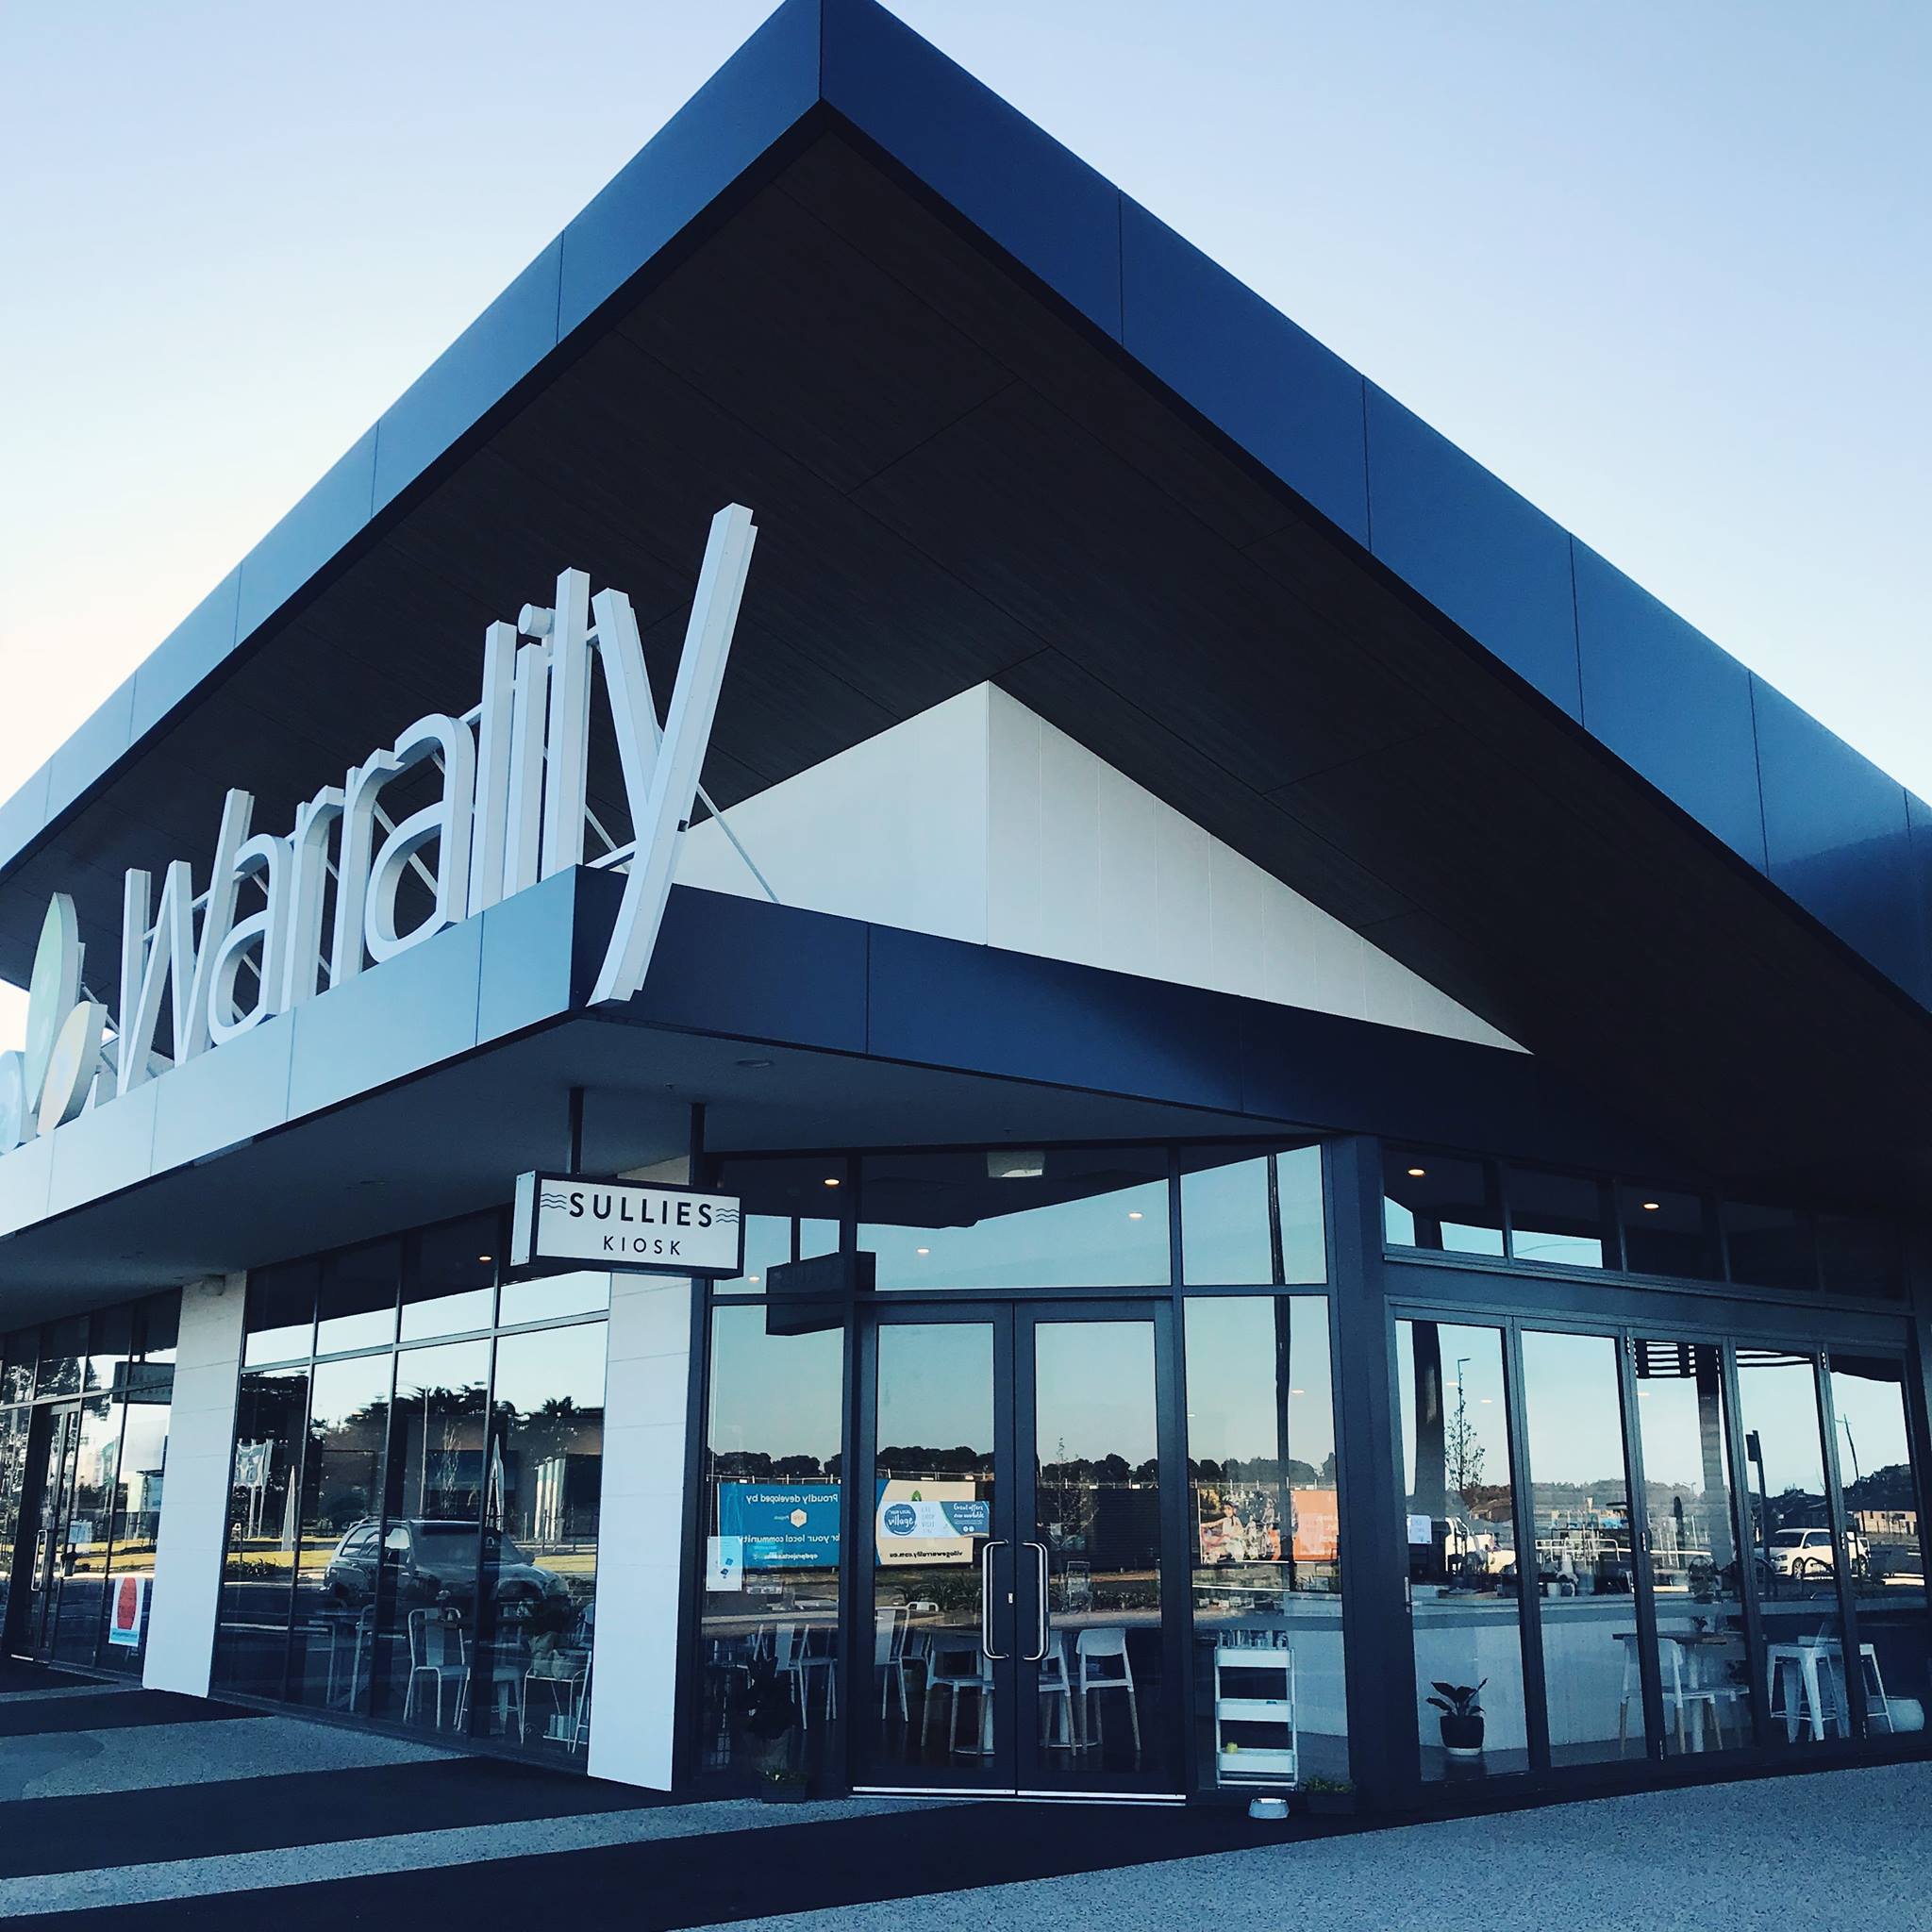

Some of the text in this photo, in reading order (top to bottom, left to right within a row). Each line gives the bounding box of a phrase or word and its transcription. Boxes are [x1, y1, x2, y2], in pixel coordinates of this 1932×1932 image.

[117, 502, 758, 1097] Warralily
[569, 1191, 712, 1228] SULLIES
[603, 1235, 681, 1256] KIOSK
[888, 1514, 914, 1528] village
